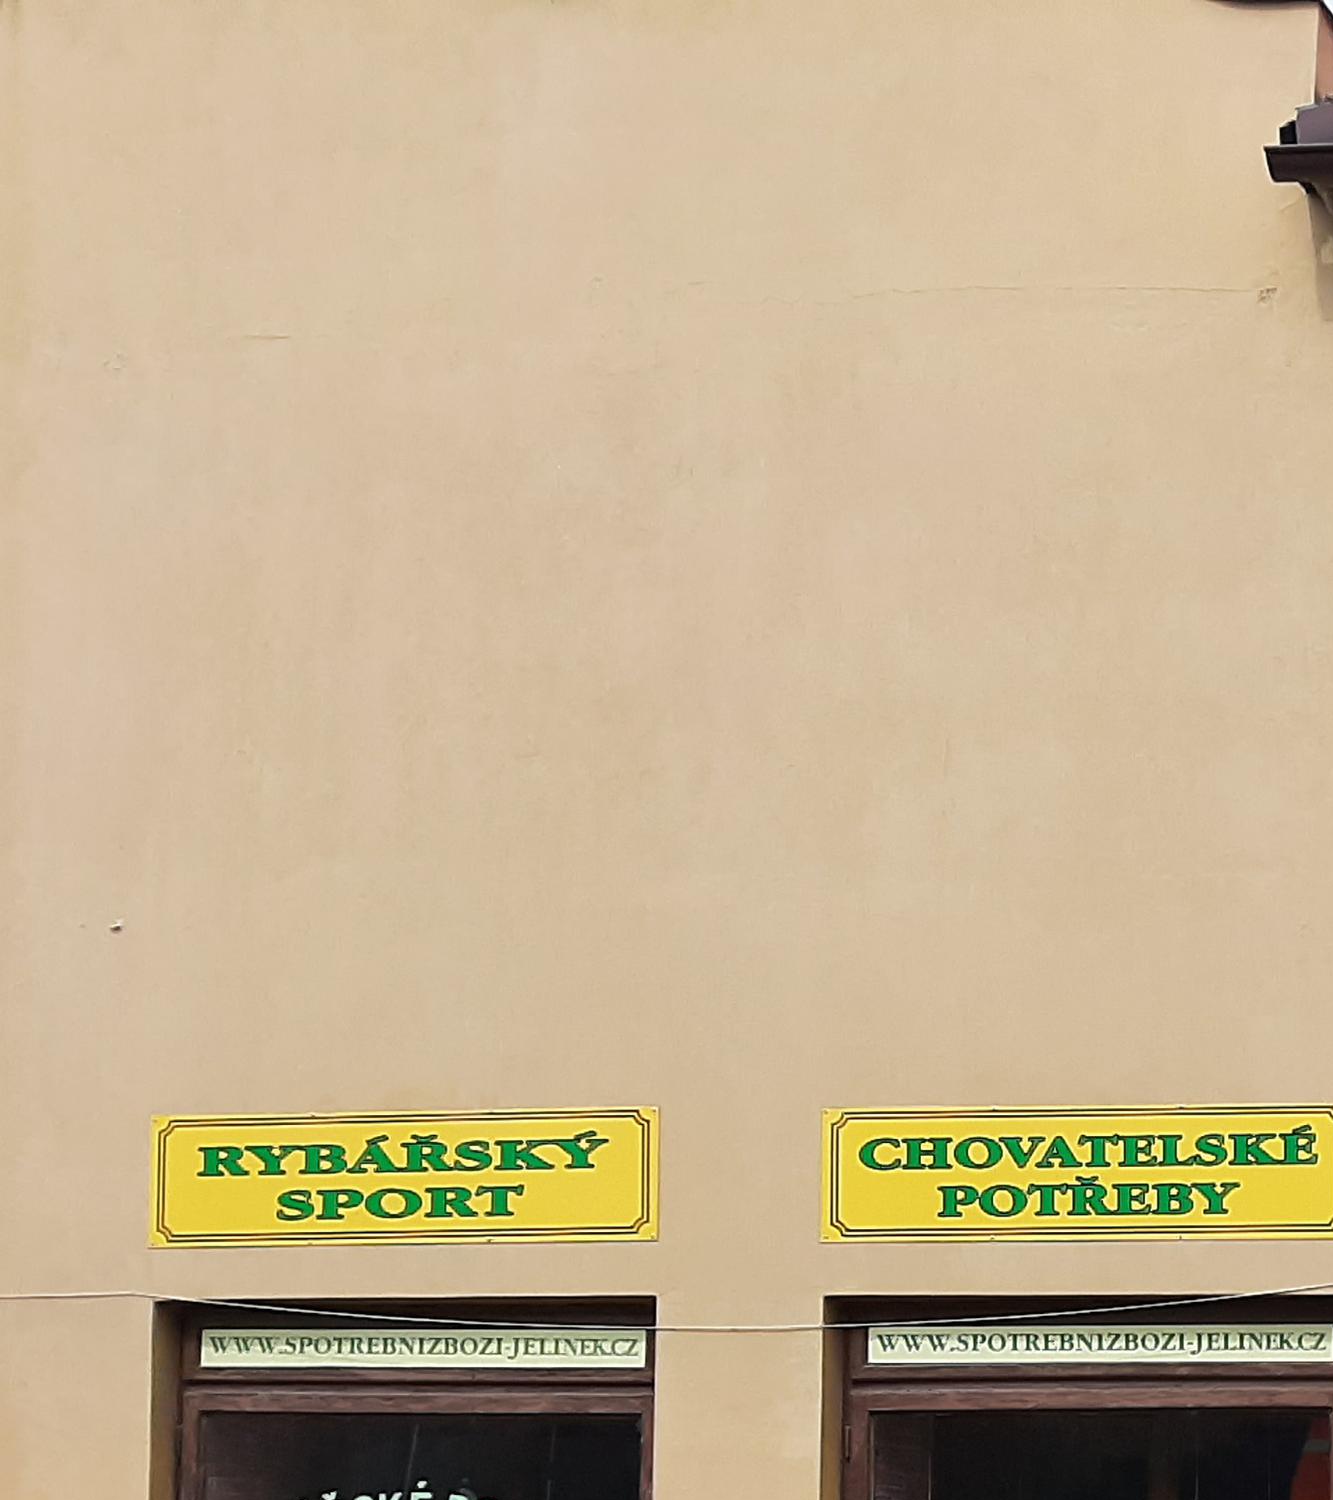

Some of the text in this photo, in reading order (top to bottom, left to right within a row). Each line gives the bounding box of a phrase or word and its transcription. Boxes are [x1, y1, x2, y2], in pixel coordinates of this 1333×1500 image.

[197, 1131, 609, 1177] RYBÁŘSKÝ
[859, 1125, 1319, 1171] CHOVATELSKÉ
[276, 1184, 525, 1221] SPORT
[937, 1176, 1240, 1218] POTŘEBY
[875, 1330, 1328, 1357] WWW.SPOTREBNIZBOZI-JELINEK.CZ
